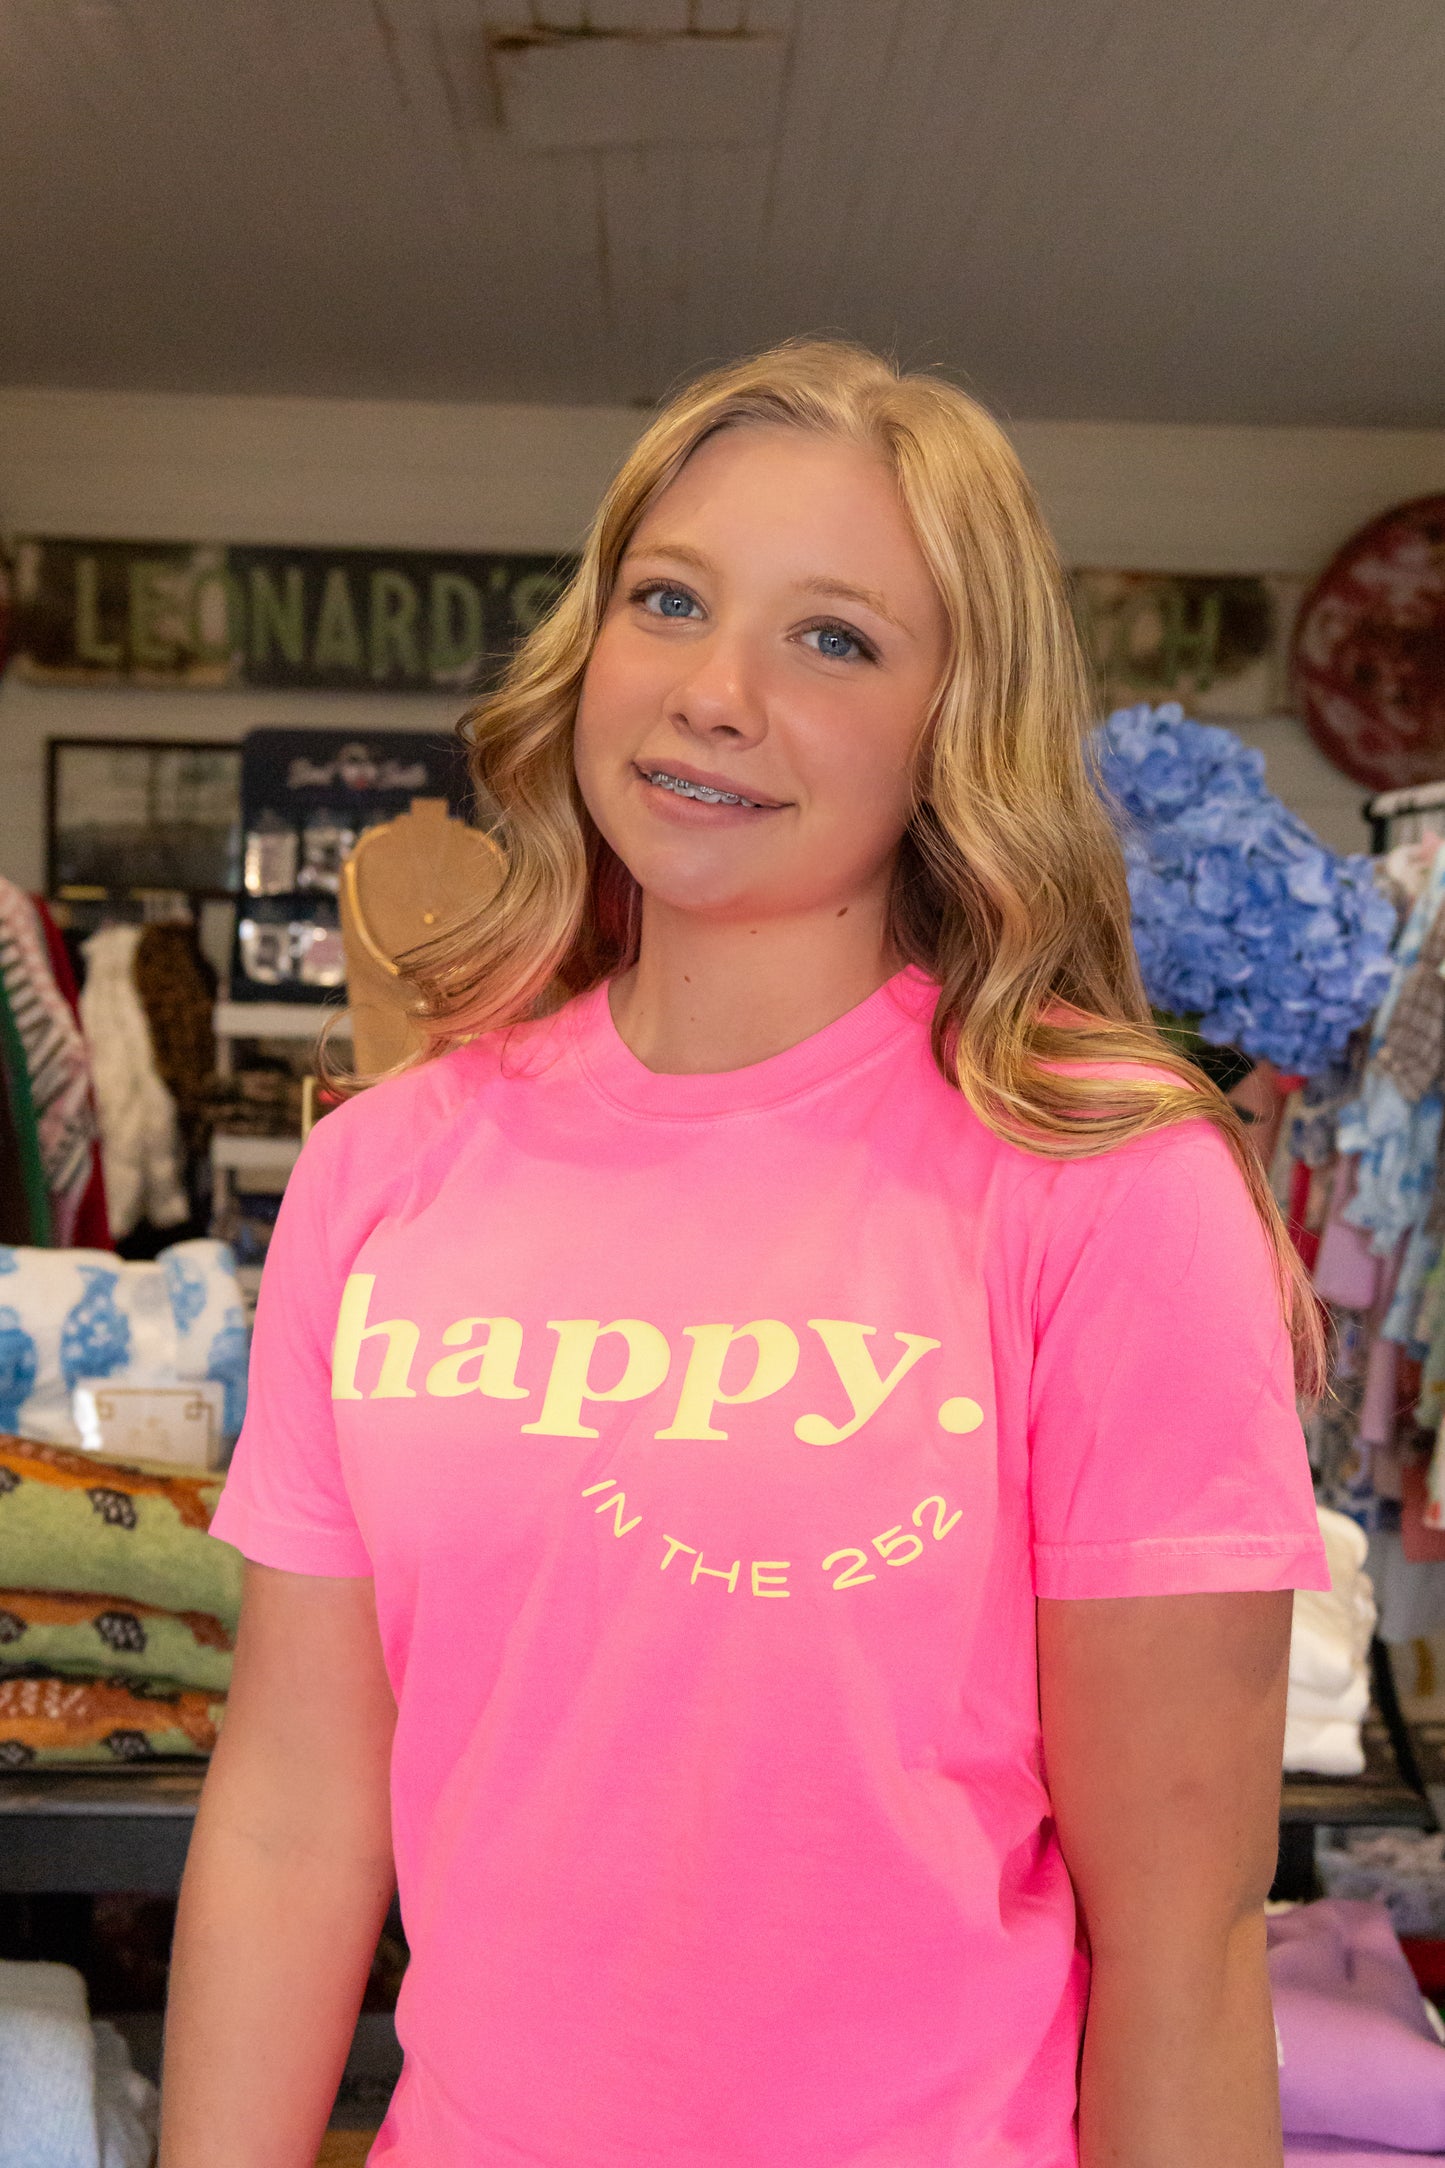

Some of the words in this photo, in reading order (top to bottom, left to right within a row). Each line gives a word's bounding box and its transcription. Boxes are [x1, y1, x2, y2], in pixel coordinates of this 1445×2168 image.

[331, 1273, 984, 1446] happy.
[581, 1479, 642, 1538] IN
[660, 1534, 791, 1598] THE
[821, 1495, 963, 1590] 252
